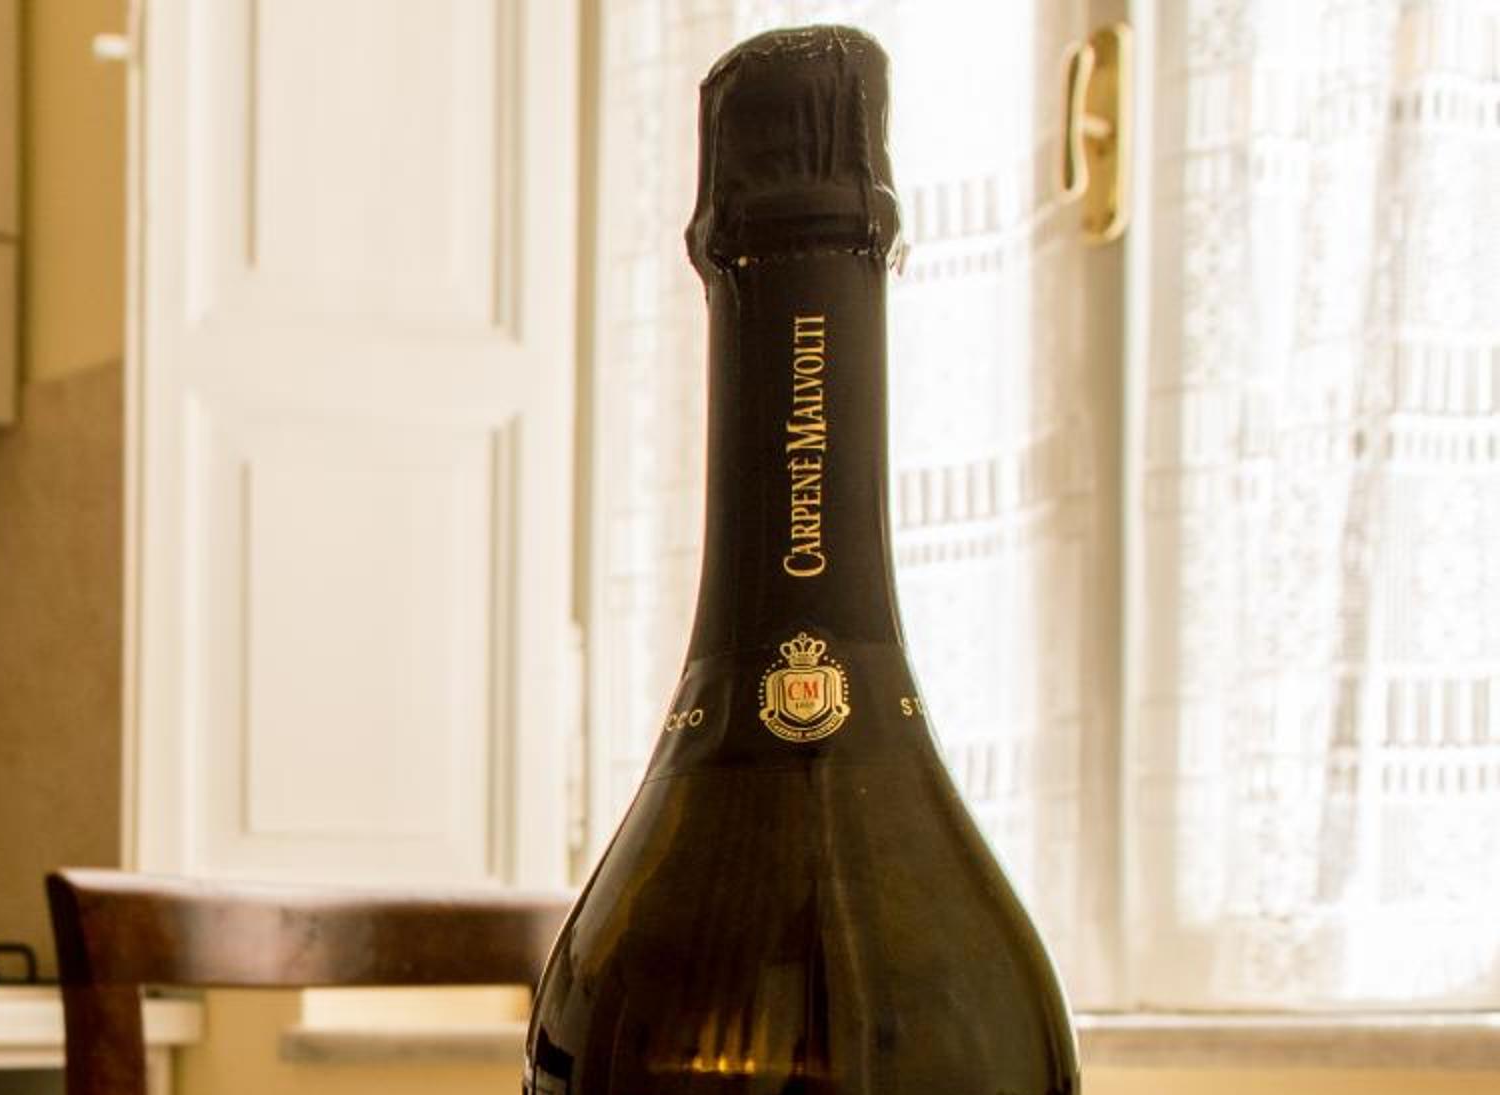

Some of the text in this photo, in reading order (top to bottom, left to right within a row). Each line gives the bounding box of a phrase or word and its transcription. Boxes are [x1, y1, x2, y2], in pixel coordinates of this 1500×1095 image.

[783, 315, 827, 577] CARPENÈ MALVOLTI
[788, 681, 819, 700] CM
